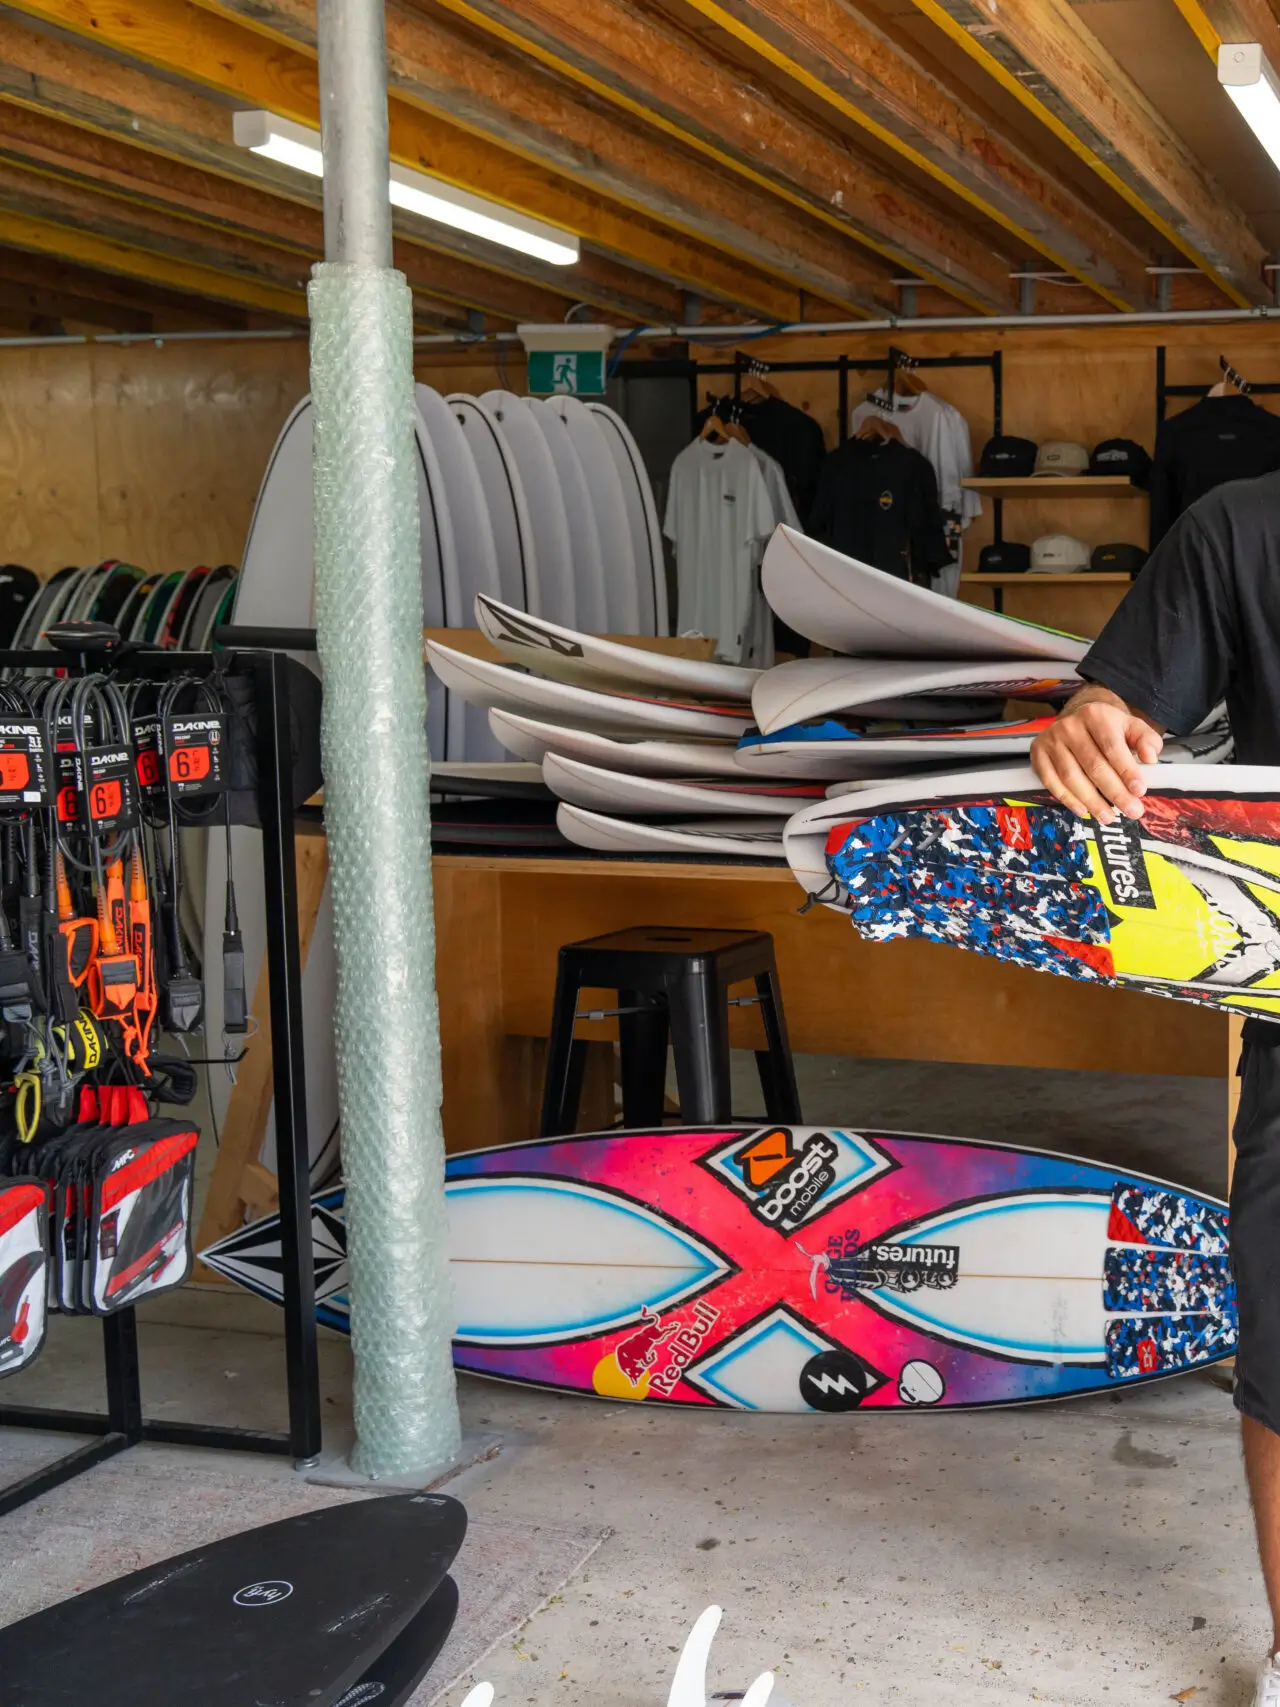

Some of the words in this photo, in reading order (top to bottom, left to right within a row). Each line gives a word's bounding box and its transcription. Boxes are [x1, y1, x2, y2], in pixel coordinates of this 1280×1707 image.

[172, 720, 221, 732] DAKINE
[91, 752, 130, 766] DAKINE
[176, 751, 190, 778] 6
[95, 786, 106, 815] 6
[1099, 813, 1140, 903] utures.
[757, 1142, 833, 1220] boost
[790, 1171, 829, 1216] mobile
[871, 1245, 956, 1269] futures.
